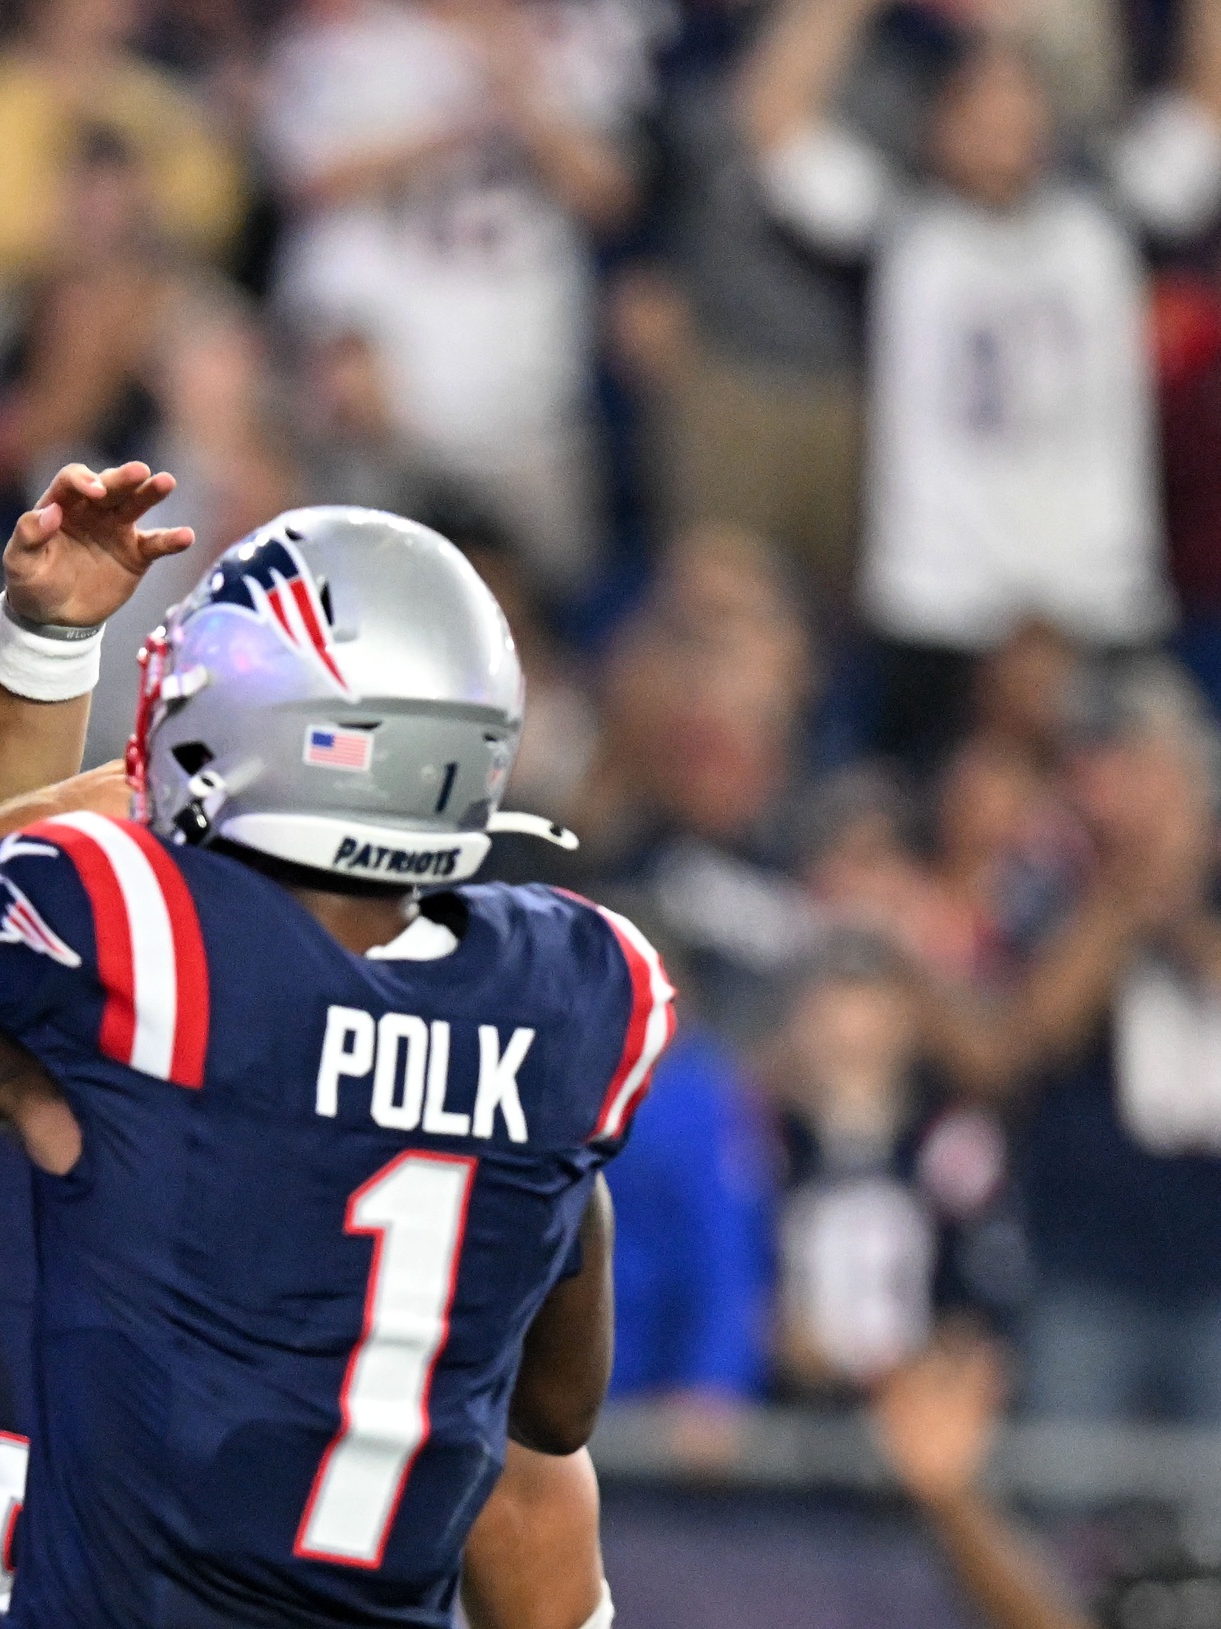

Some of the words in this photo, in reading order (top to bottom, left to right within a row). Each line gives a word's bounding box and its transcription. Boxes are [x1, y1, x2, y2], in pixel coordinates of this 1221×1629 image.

[435, 762, 458, 814] 1
[333, 837, 462, 876] PATRIOTS
[315, 1005, 536, 1143] POLK
[292, 1148, 478, 1570] 1
